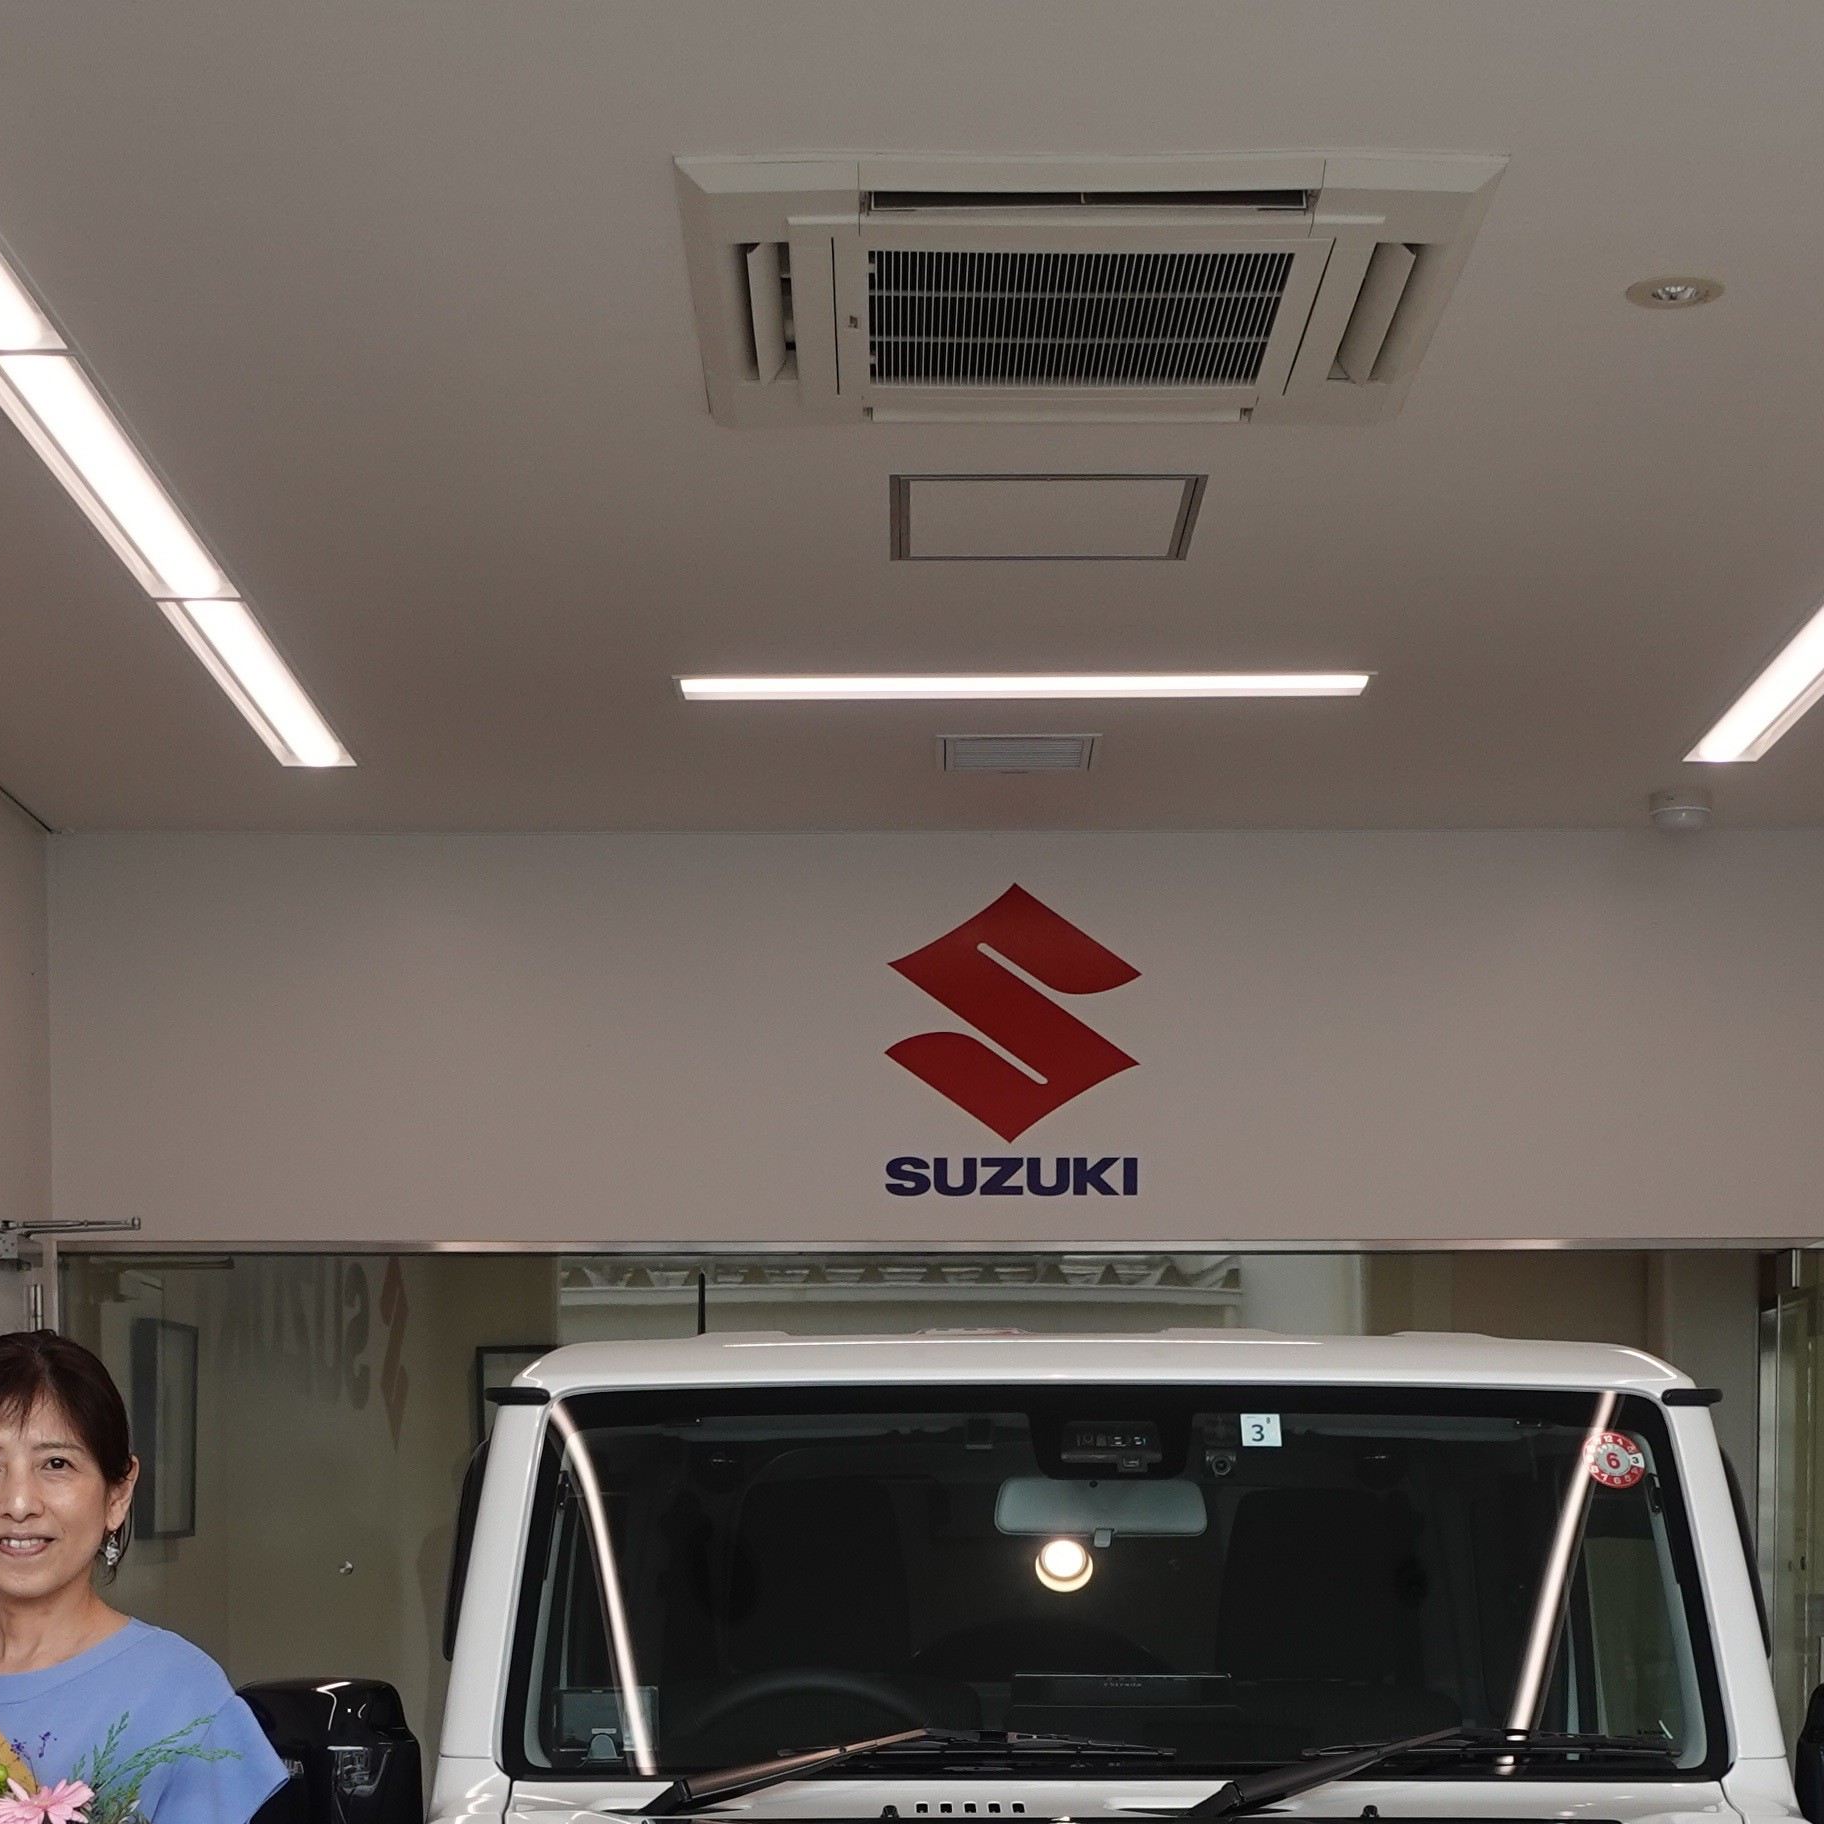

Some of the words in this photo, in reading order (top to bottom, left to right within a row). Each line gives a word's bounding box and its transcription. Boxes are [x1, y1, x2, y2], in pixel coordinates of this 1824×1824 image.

[884, 1156, 1139, 1196] SUZUKI
[1251, 1423, 1265, 1442] 3
[1606, 1452, 1621, 1469] 6
[1631, 1456, 1640, 1464] 3
